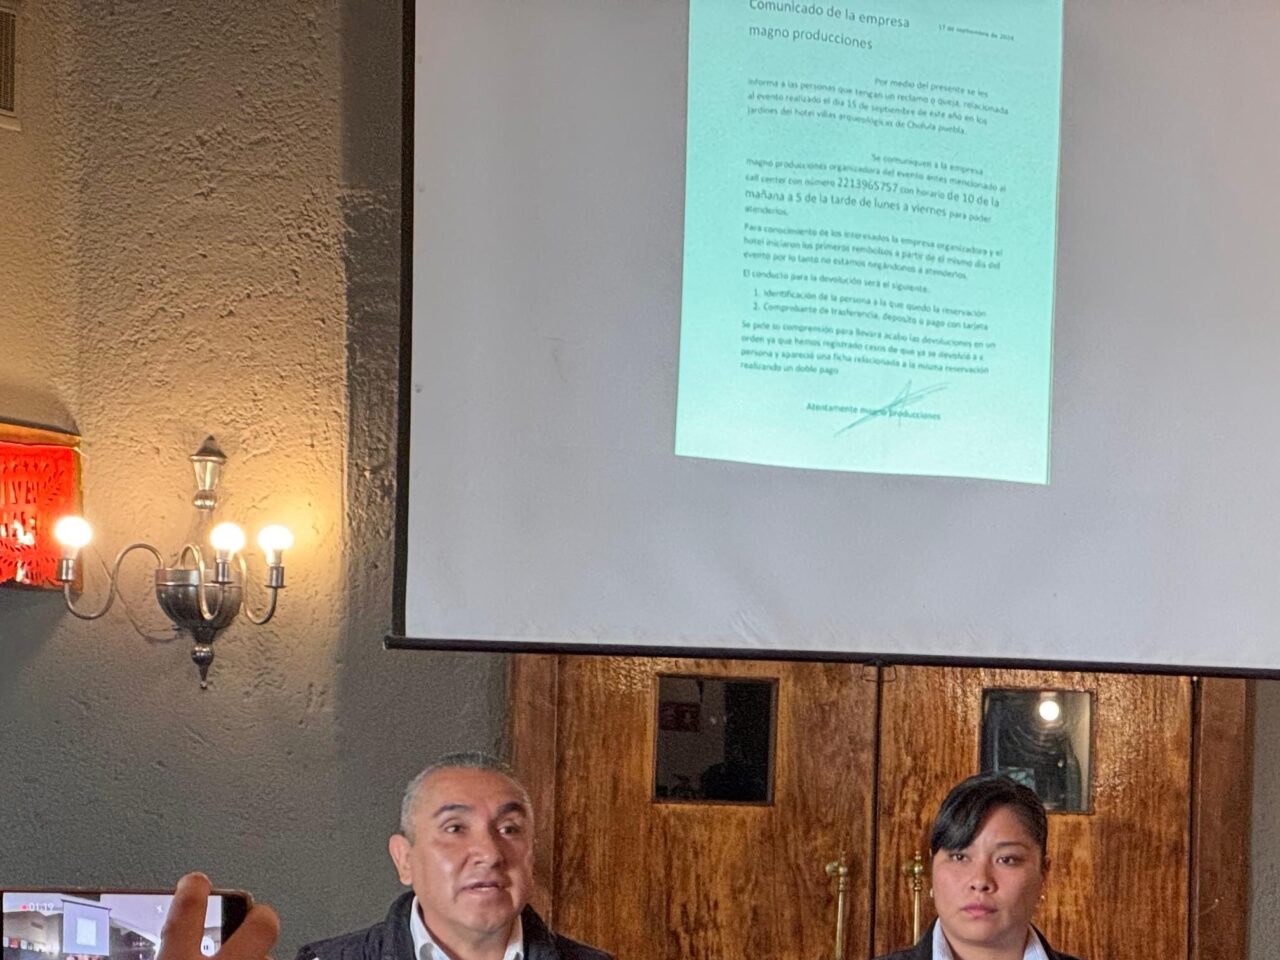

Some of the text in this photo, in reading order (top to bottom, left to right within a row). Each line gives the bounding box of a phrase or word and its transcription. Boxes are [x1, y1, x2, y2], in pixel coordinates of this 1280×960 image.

[749, 0, 909, 28] Comunicado de la empresa
[748, 26, 872, 50] magno producciones
[744, 189, 784, 201] mañana
[787, 193, 793, 201] a
[795, 192, 802, 202] 5
[804, 193, 816, 203] de
[819, 193, 827, 203] la
[830, 194, 856, 206] tarde
[859, 196, 871, 208] de
[873, 197, 900, 210] lunes
[903, 203, 908, 211] a
[911, 204, 946, 216] viernes
[837, 176, 898, 192] 2213965757
[946, 191, 959, 201] de
[962, 192, 974, 204] 10
[976, 195, 988, 206] de
[991, 197, 999, 207] la
